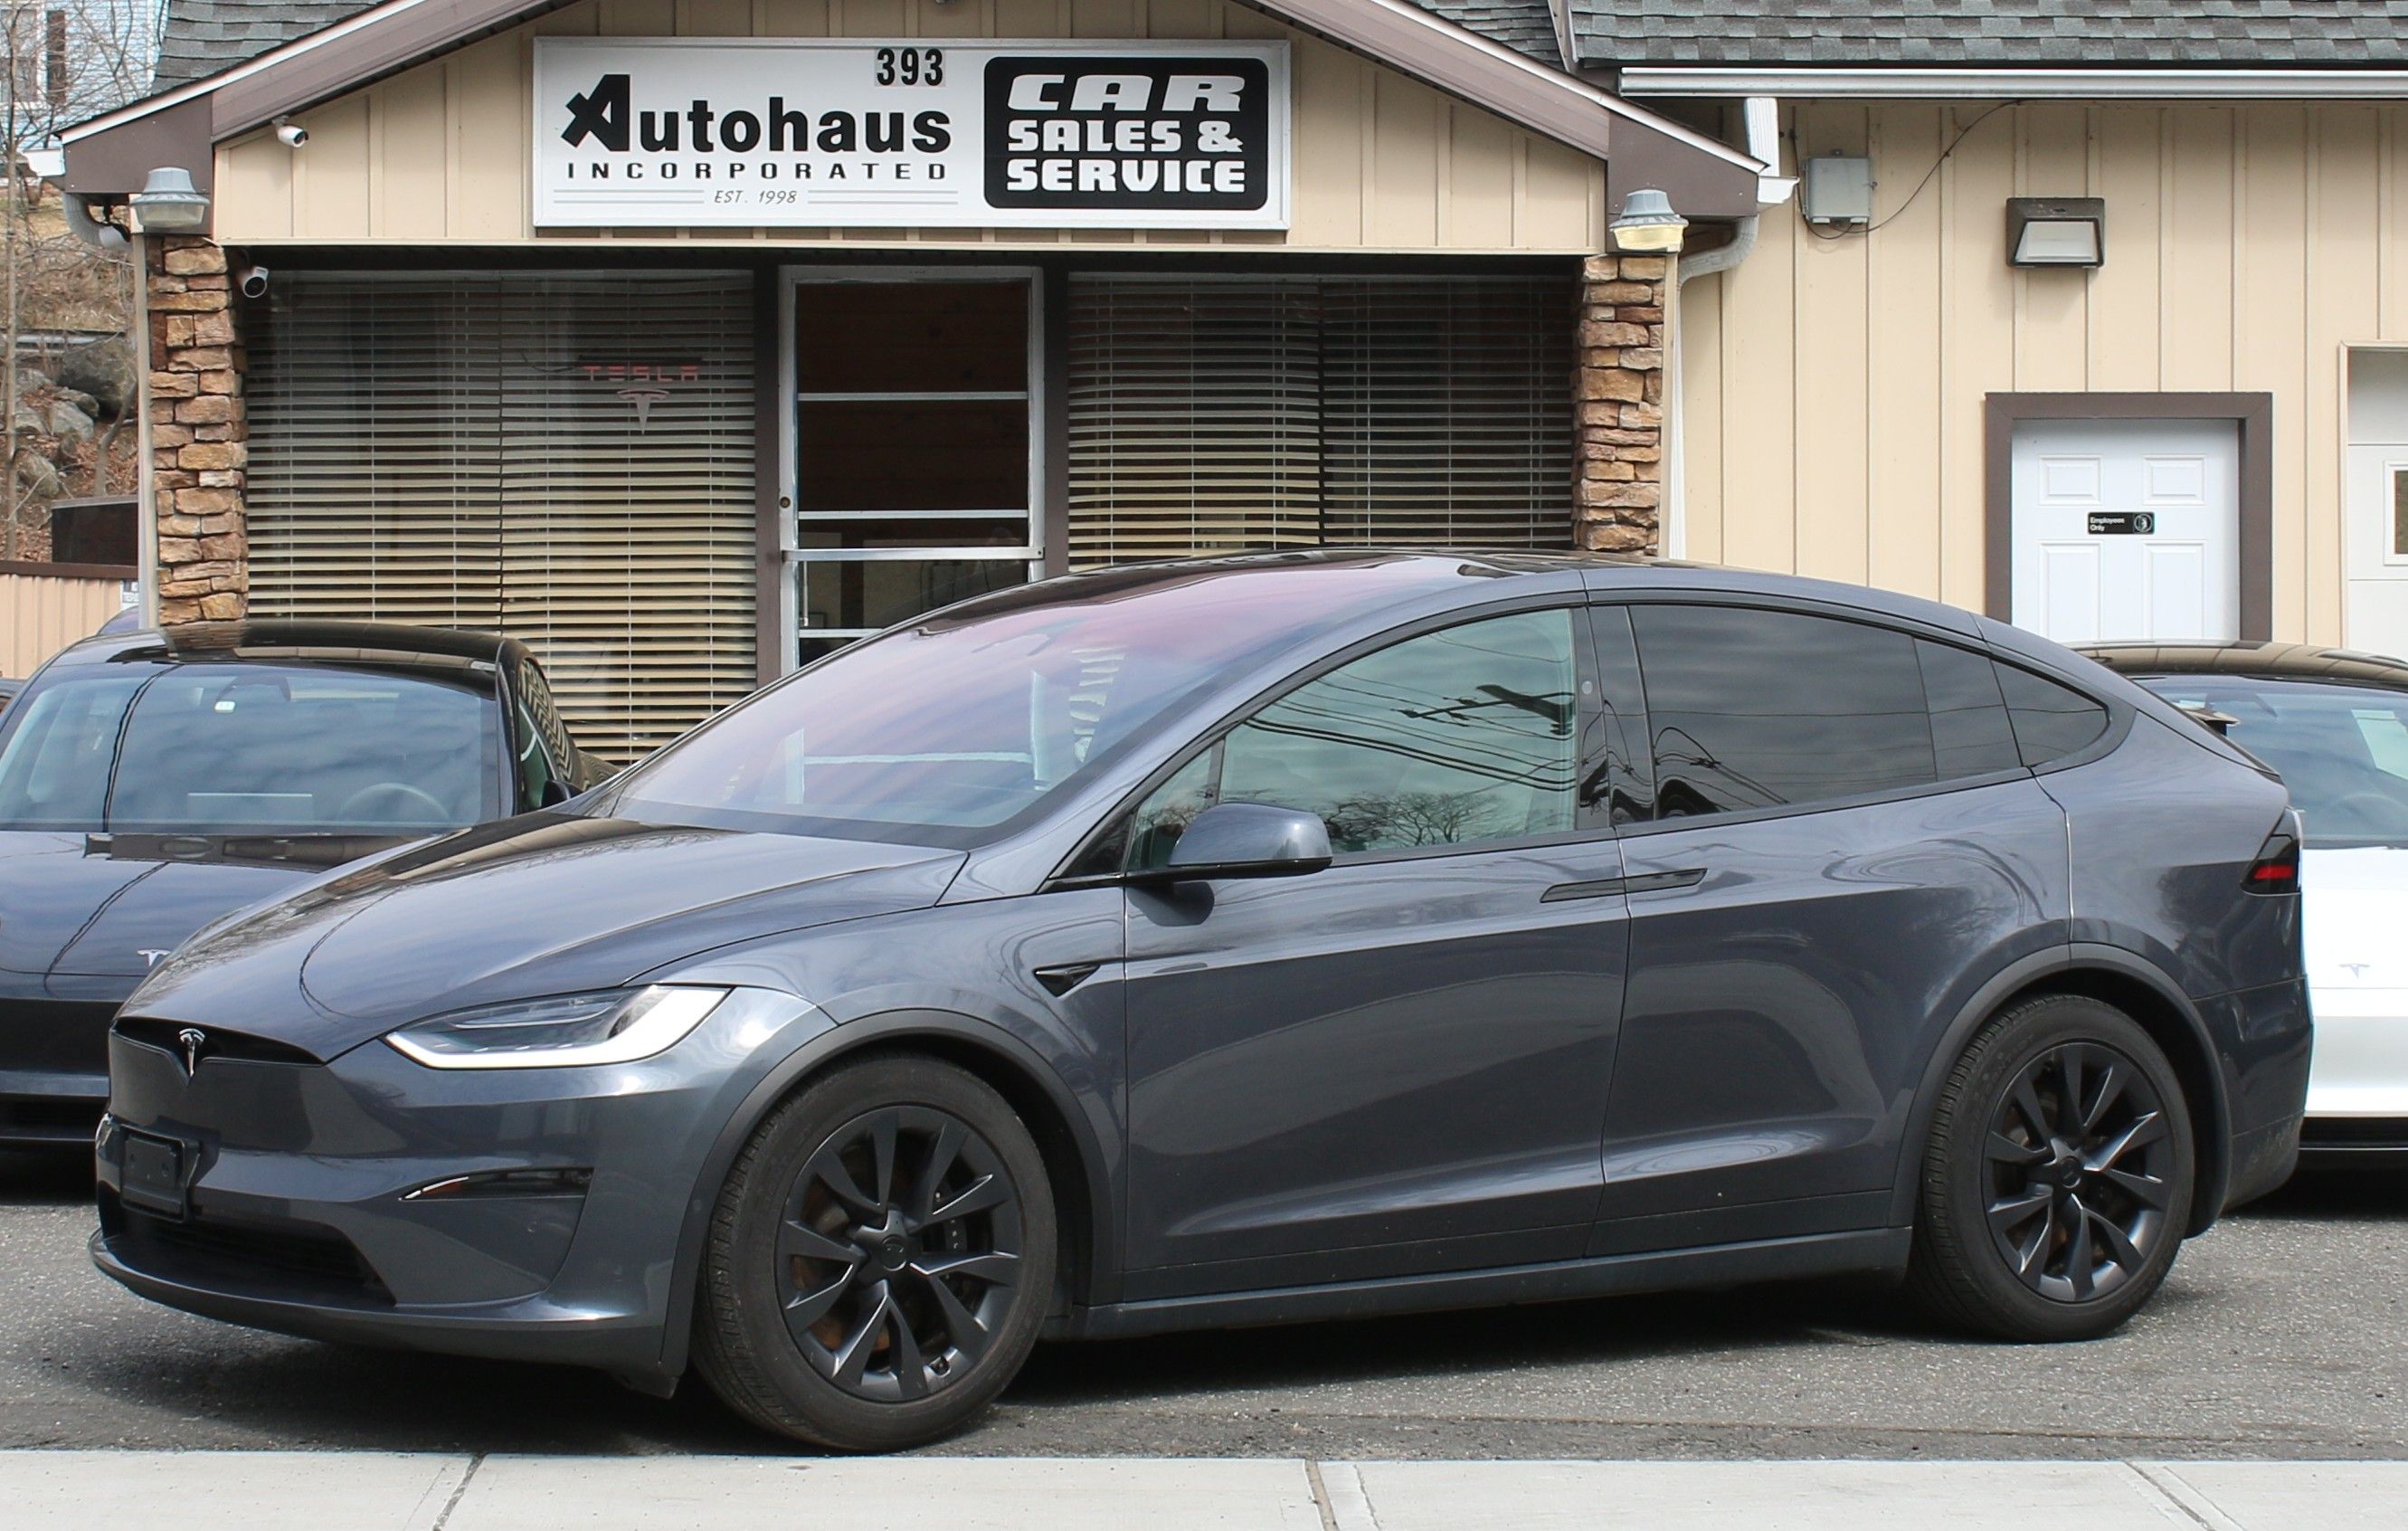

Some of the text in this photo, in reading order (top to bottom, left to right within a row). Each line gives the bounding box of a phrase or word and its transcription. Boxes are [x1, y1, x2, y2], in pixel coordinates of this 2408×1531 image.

[877, 48, 943, 86] 393
[1008, 74, 1245, 111] CAR
[561, 74, 951, 153] Autohaus
[1008, 119, 1244, 152] SALES &
[568, 162, 945, 179] INCORPORATED
[1007, 158, 1245, 192] SERVICE
[714, 190, 798, 204] EST. 1998
[582, 366, 701, 382] TESLA
